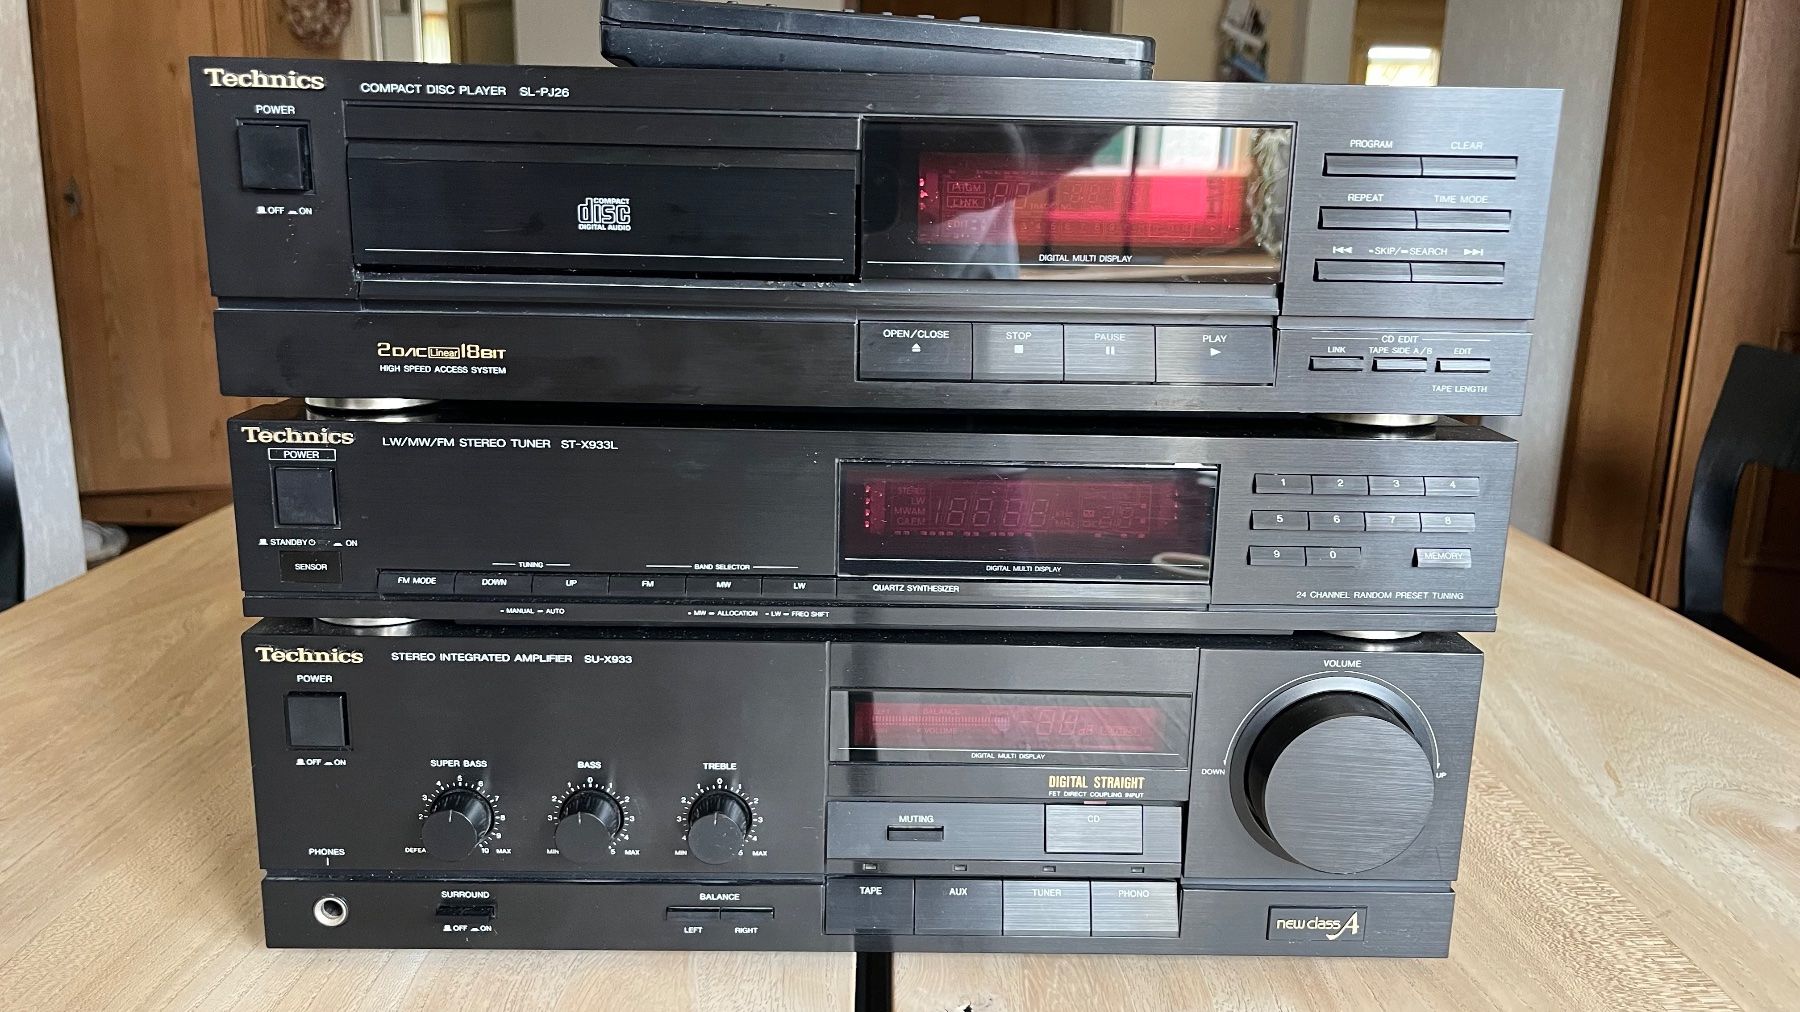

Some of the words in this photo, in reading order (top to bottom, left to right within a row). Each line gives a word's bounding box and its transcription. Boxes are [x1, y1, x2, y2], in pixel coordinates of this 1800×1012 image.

[204, 68, 325, 90] Technics
[360, 82, 422, 94] COMPACT
[426, 83, 455, 95] DISC
[459, 84, 506, 96] PLAYER
[519, 86, 569, 98] SL-PJ26
[256, 105, 295, 115] POWER
[1350, 140, 1393, 148] PROGRAM
[1450, 141, 1483, 150] CLEAR
[1348, 194, 1384, 202] REPEAT
[1434, 195, 1456, 203] TIME
[1460, 195, 1488, 204] MODE
[267, 206, 284, 215] OFF
[298, 207, 312, 215] ON
[577, 197, 631, 224] disc
[1039, 254, 1069, 262] DIGITAL
[1072, 254, 1097, 263] MULTI
[1099, 254, 1133, 264] DISPLAY
[883, 329, 950, 339] OPEN/CLOSE
[1006, 332, 1032, 341] STOP
[1094, 332, 1126, 342] PAUSE
[1202, 334, 1227, 344] PLAY
[1381, 335, 1394, 343] CD
[430, 348, 458, 357] Linear
[1327, 346, 1346, 354] LINK
[1413, 347, 1433, 355] A/B
[379, 364, 400, 372] HIGH
[404, 365, 431, 373] SPEED
[434, 365, 468, 374] ACCESS
[471, 366, 507, 374] SYSTEM
[1455, 385, 1488, 393] LENGTH
[241, 427, 355, 444] Technics
[382, 437, 455, 448] LW/MW/FM
[459, 438, 507, 448] STEREO
[510, 439, 551, 449] TUNER
[560, 439, 618, 450] ST-X933L
[283, 450, 320, 459] POWER
[1281, 478, 1286, 486] 1
[1337, 479, 1344, 488] 2
[1393, 479, 1400, 488] 3
[1449, 480, 1456, 488] 4
[1276, 514, 1283, 523] 5
[1333, 515, 1340, 524] 6
[1389, 516, 1396, 524] 7
[1445, 516, 1451, 525] 8
[346, 539, 358, 547] ON
[1273, 550, 1280, 559] 9
[1330, 550, 1336, 559] 0
[1424, 552, 1463, 560] MEMORY
[294, 563, 328, 571] SENSOR
[986, 564, 1011, 572] DIGITAL
[1034, 565, 1061, 573] DISPLAY
[412, 577, 436, 585] MODE
[481, 578, 507, 586] DOWN
[565, 579, 577, 587] UP
[872, 584, 904, 592] QUARTZ
[906, 585, 959, 593] SYNTHESIZER
[1310, 591, 1350, 599] CHANNEL
[1432, 592, 1464, 600] TUNING
[254, 647, 363, 664] Technics
[391, 652, 435, 662] STEREO
[439, 653, 511, 663] INTEGRATED
[514, 653, 573, 663] AMPLIFIER
[583, 654, 632, 664] SU-X933
[1323, 660, 1361, 668] VOLUME
[296, 675, 333, 683] POWER
[306, 758, 321, 766] OFF
[463, 760, 488, 768] BASS
[577, 761, 602, 769] BASS
[702, 762, 737, 770] TREBLE
[1049, 775, 1088, 788] DIGITAL
[1094, 776, 1145, 789] STRAIGHT
[899, 815, 934, 823] MUTING
[1087, 815, 1100, 823] CD
[308, 848, 345, 856] PHONES
[441, 891, 490, 899] SURROUND
[859, 887, 882, 895] TAPE
[949, 887, 968, 896] AUX
[1032, 889, 1062, 897] TUNER
[1118, 889, 1150, 898] PHONO
[734, 927, 758, 935] RIGHT
